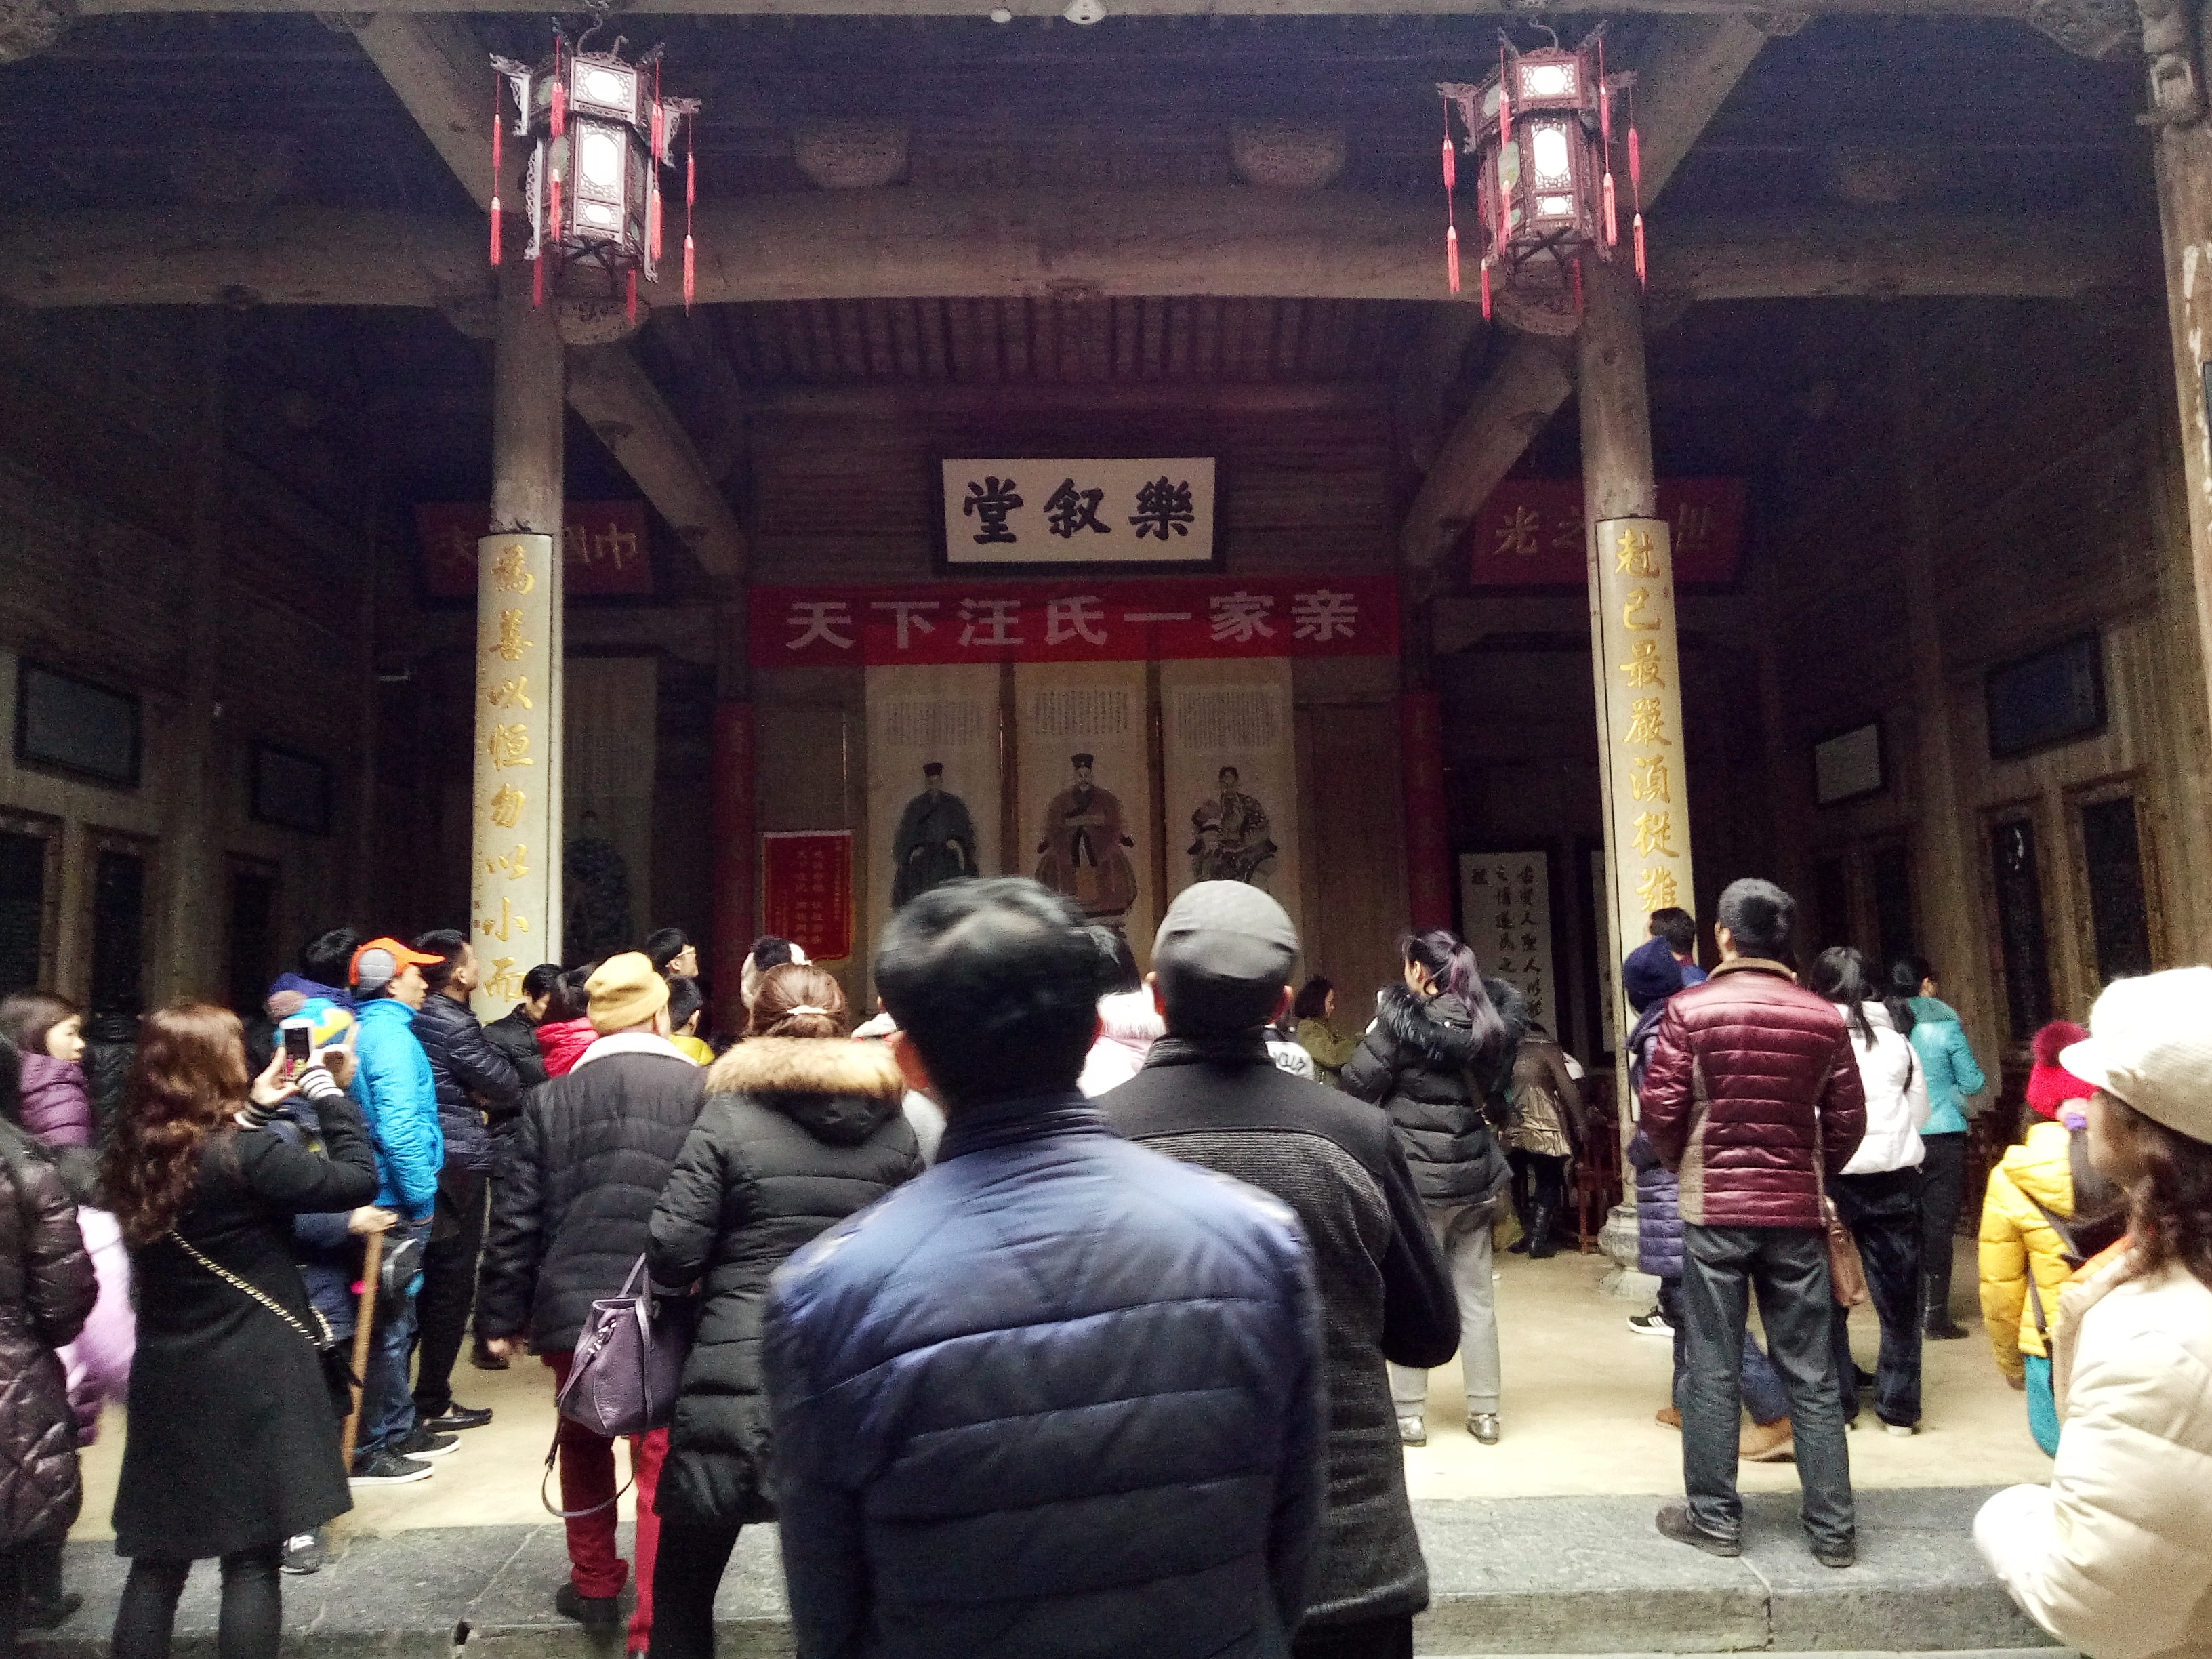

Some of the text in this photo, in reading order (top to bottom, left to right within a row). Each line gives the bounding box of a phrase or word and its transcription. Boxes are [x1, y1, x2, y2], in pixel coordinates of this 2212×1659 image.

[785, 588, 1359, 651] 天下汪氏一家亲
